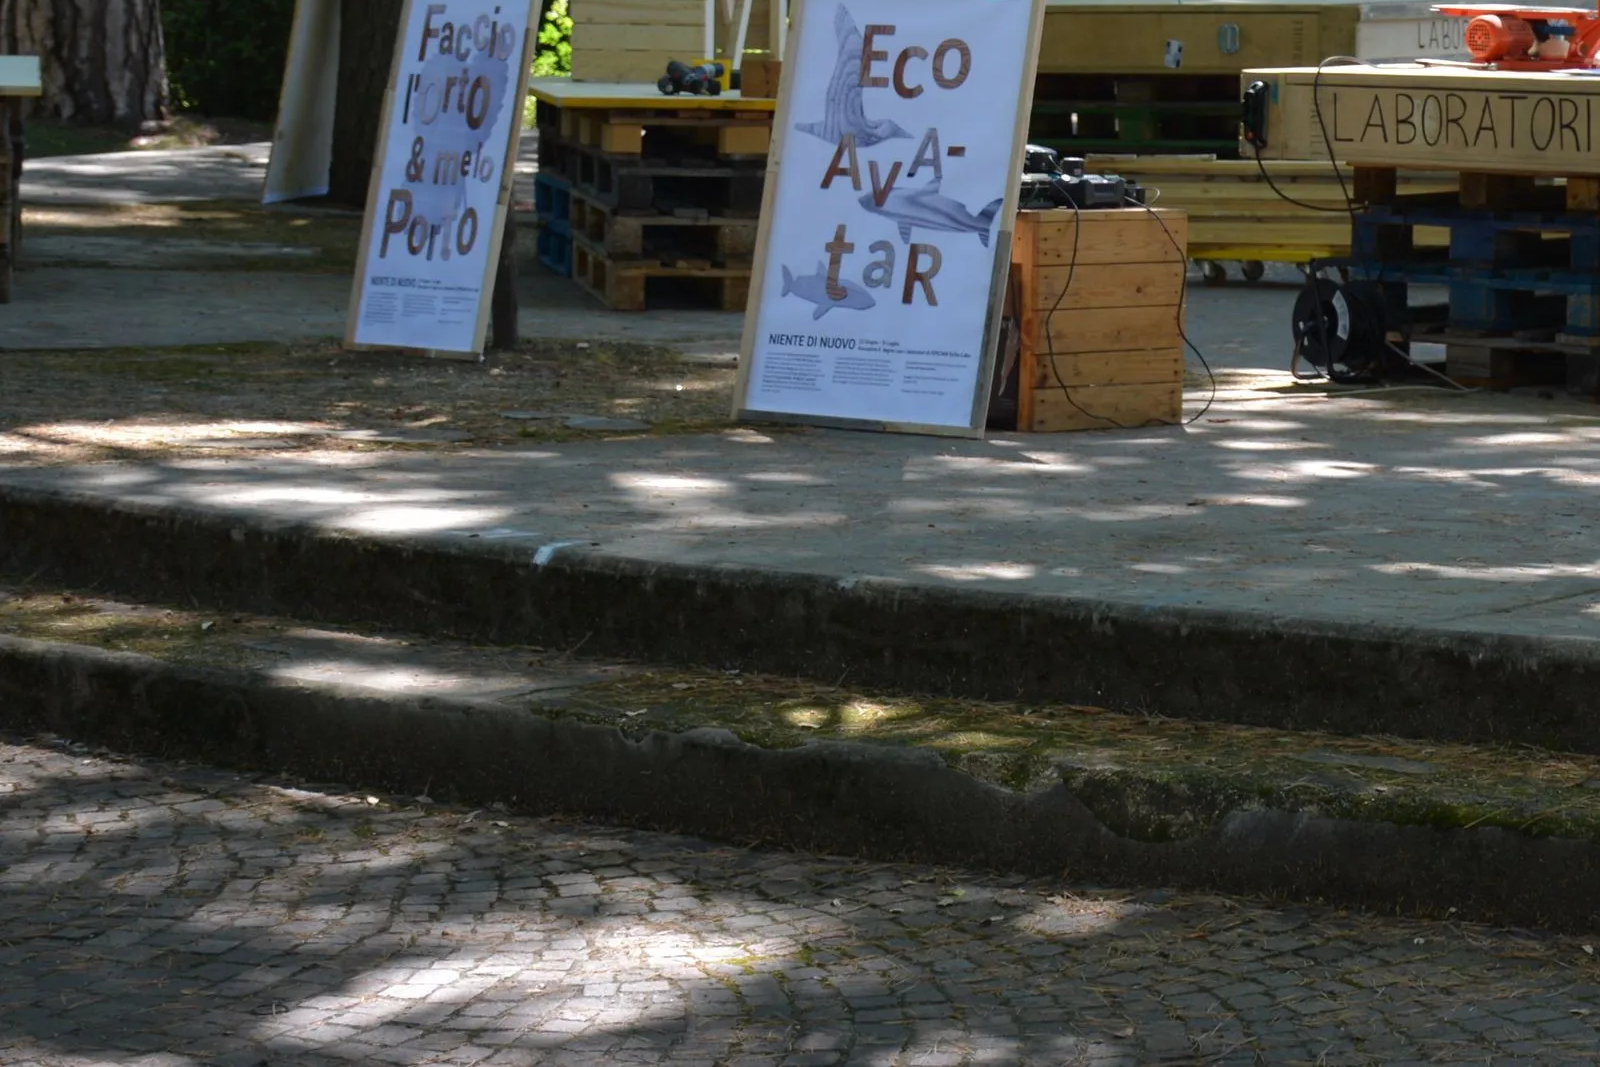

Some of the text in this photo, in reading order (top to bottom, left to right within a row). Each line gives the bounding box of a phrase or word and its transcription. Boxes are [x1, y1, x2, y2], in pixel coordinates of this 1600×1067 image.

[418, 3, 515, 62] Faccio
[405, 136, 494, 186] & melo
[768, 334, 805, 346] NIENTE
[807, 336, 817, 347] DI
[819, 337, 855, 350] NUOVO
